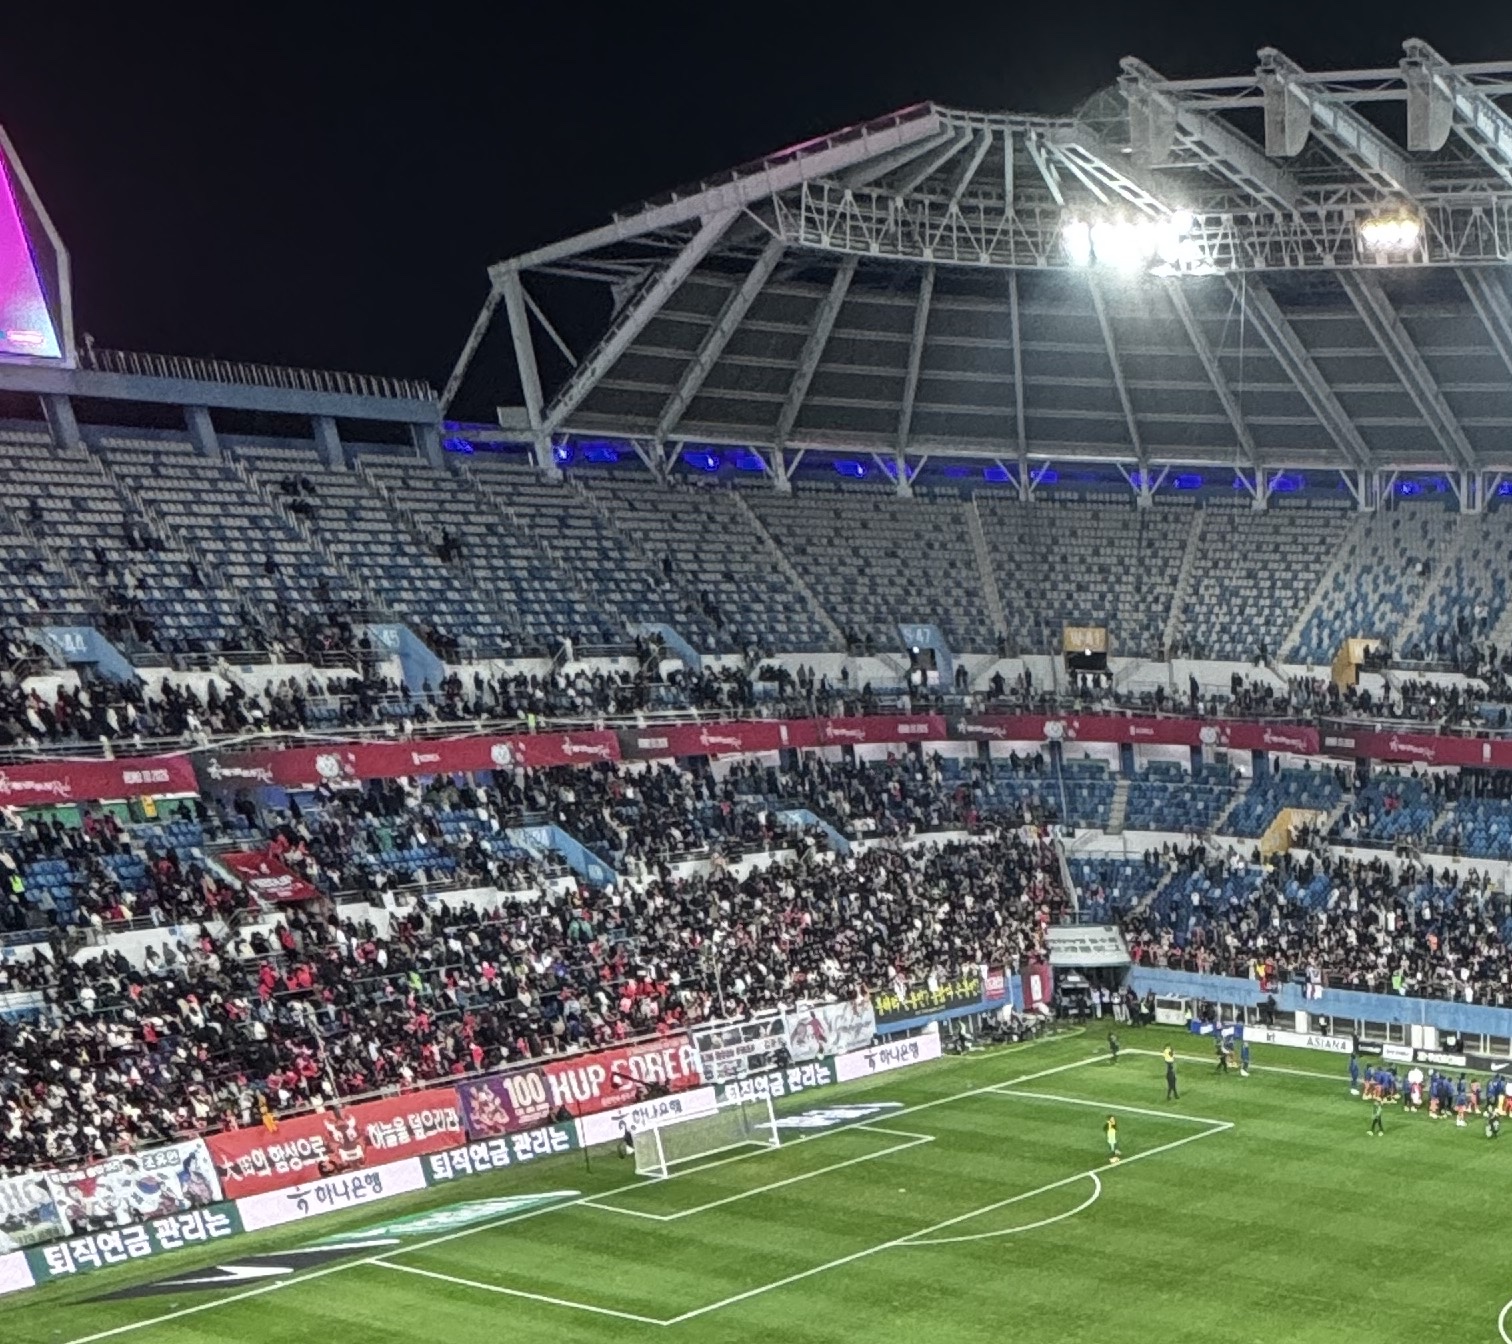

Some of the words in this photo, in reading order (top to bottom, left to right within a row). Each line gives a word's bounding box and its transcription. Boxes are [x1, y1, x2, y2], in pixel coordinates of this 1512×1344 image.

[880, 1041, 919, 1065] 하나은행
[503, 1072, 547, 1109] 100
[547, 1067, 605, 1107] HUP
[786, 1062, 832, 1093] 관리는
[430, 1139, 508, 1180] 퇴직연금
[512, 1126, 571, 1162] 관리는
[316, 1171, 383, 1205] 하나은행
[43, 1225, 152, 1275] 퇴직연금
[153, 1209, 232, 1249] 관리는
